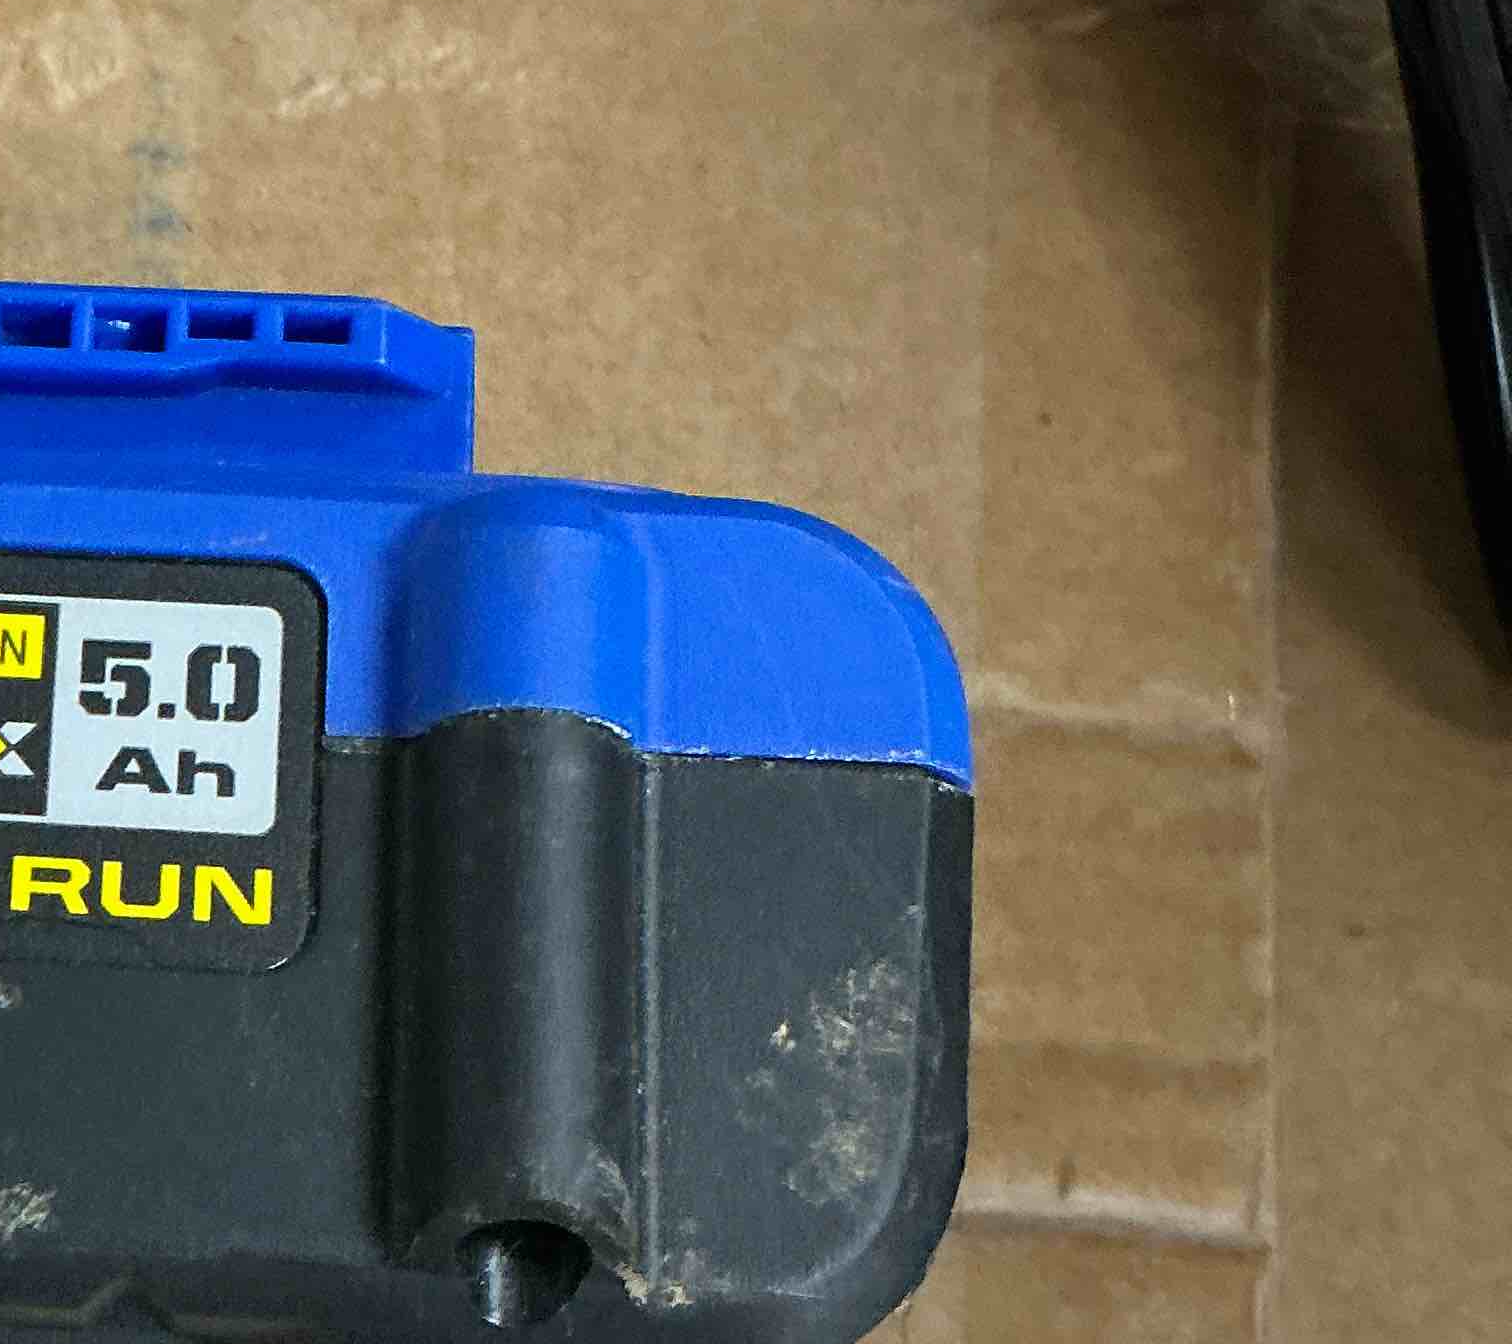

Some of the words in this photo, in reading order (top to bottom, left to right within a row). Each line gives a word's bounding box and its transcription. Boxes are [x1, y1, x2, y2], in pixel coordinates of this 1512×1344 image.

[78, 638, 262, 723] 5.0
[94, 746, 236, 798] Ah
[9, 854, 274, 926] RUN
